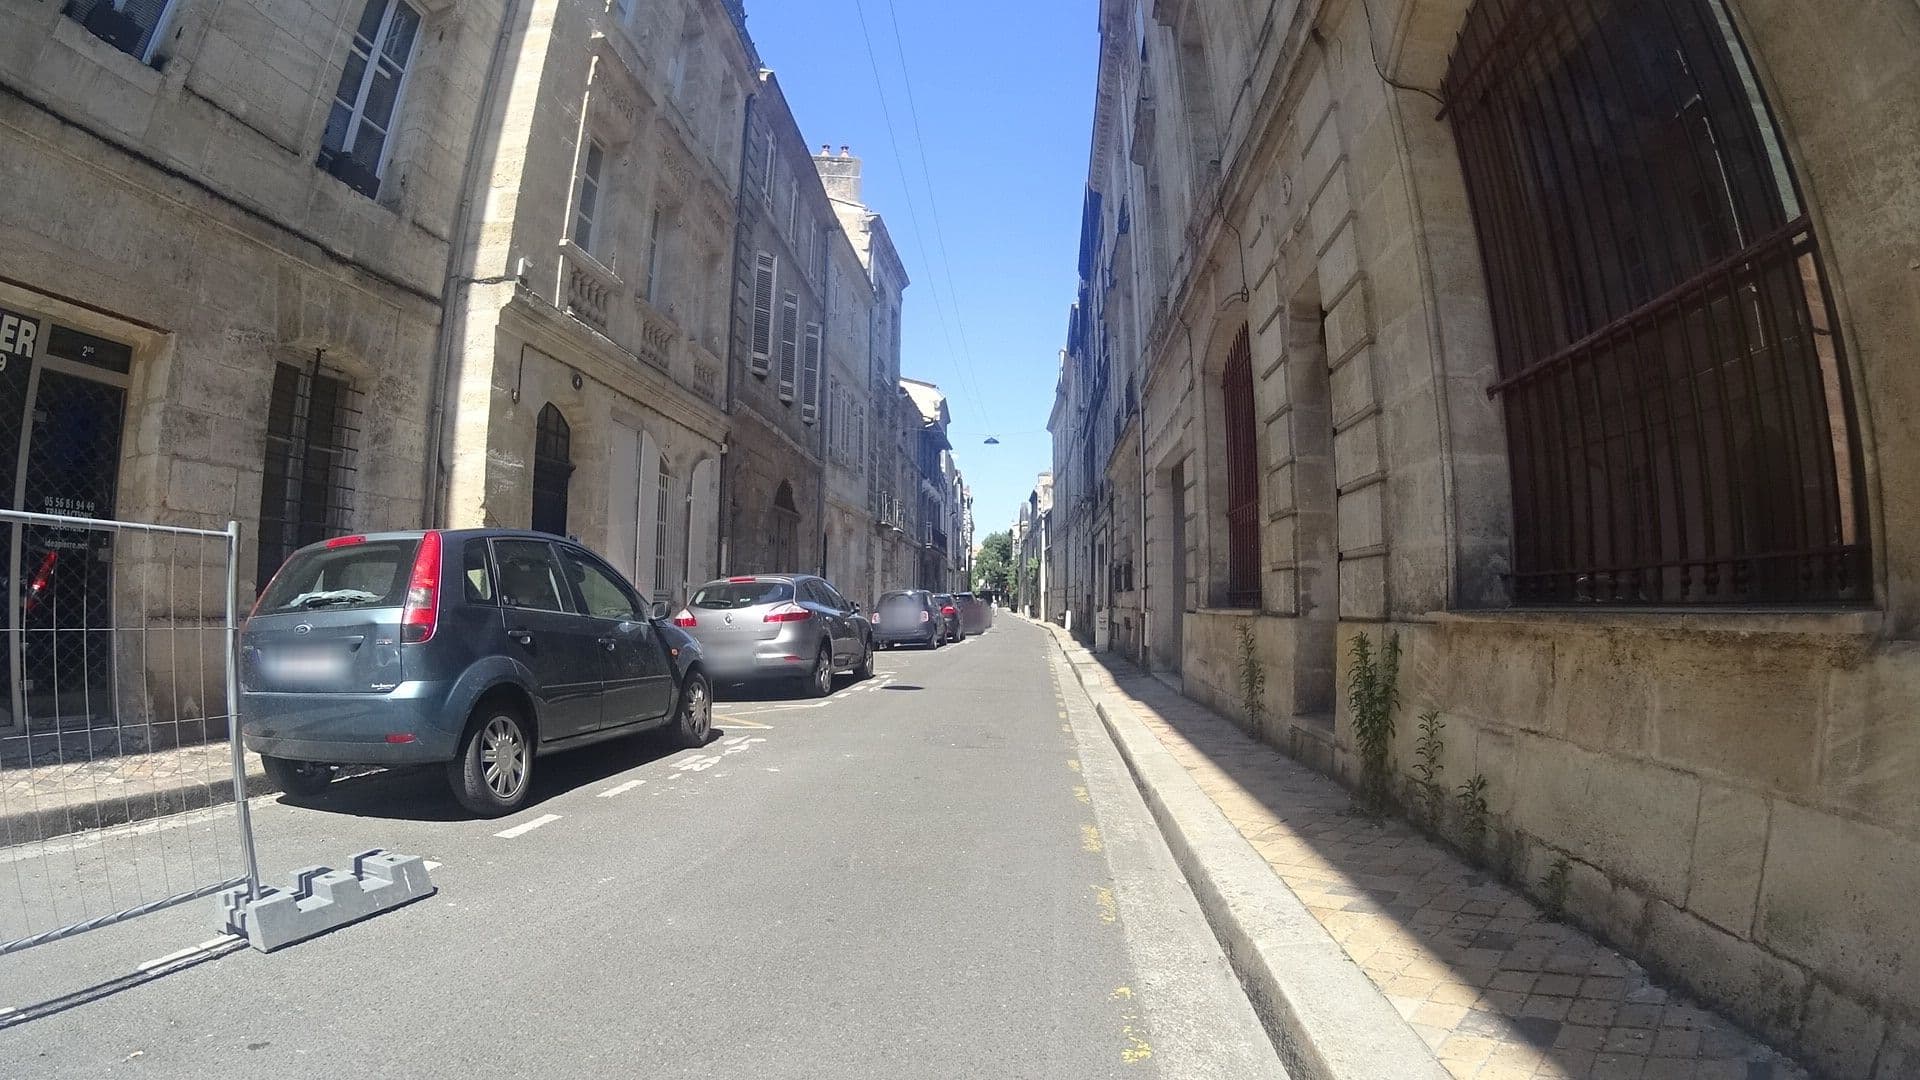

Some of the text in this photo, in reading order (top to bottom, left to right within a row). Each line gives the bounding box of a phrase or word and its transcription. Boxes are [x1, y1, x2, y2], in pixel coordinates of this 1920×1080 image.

[0, 314, 37, 358] ER
[44, 495, 53, 507] 05
[55, 497, 64, 508] 56
[76, 500, 85, 511] 94
